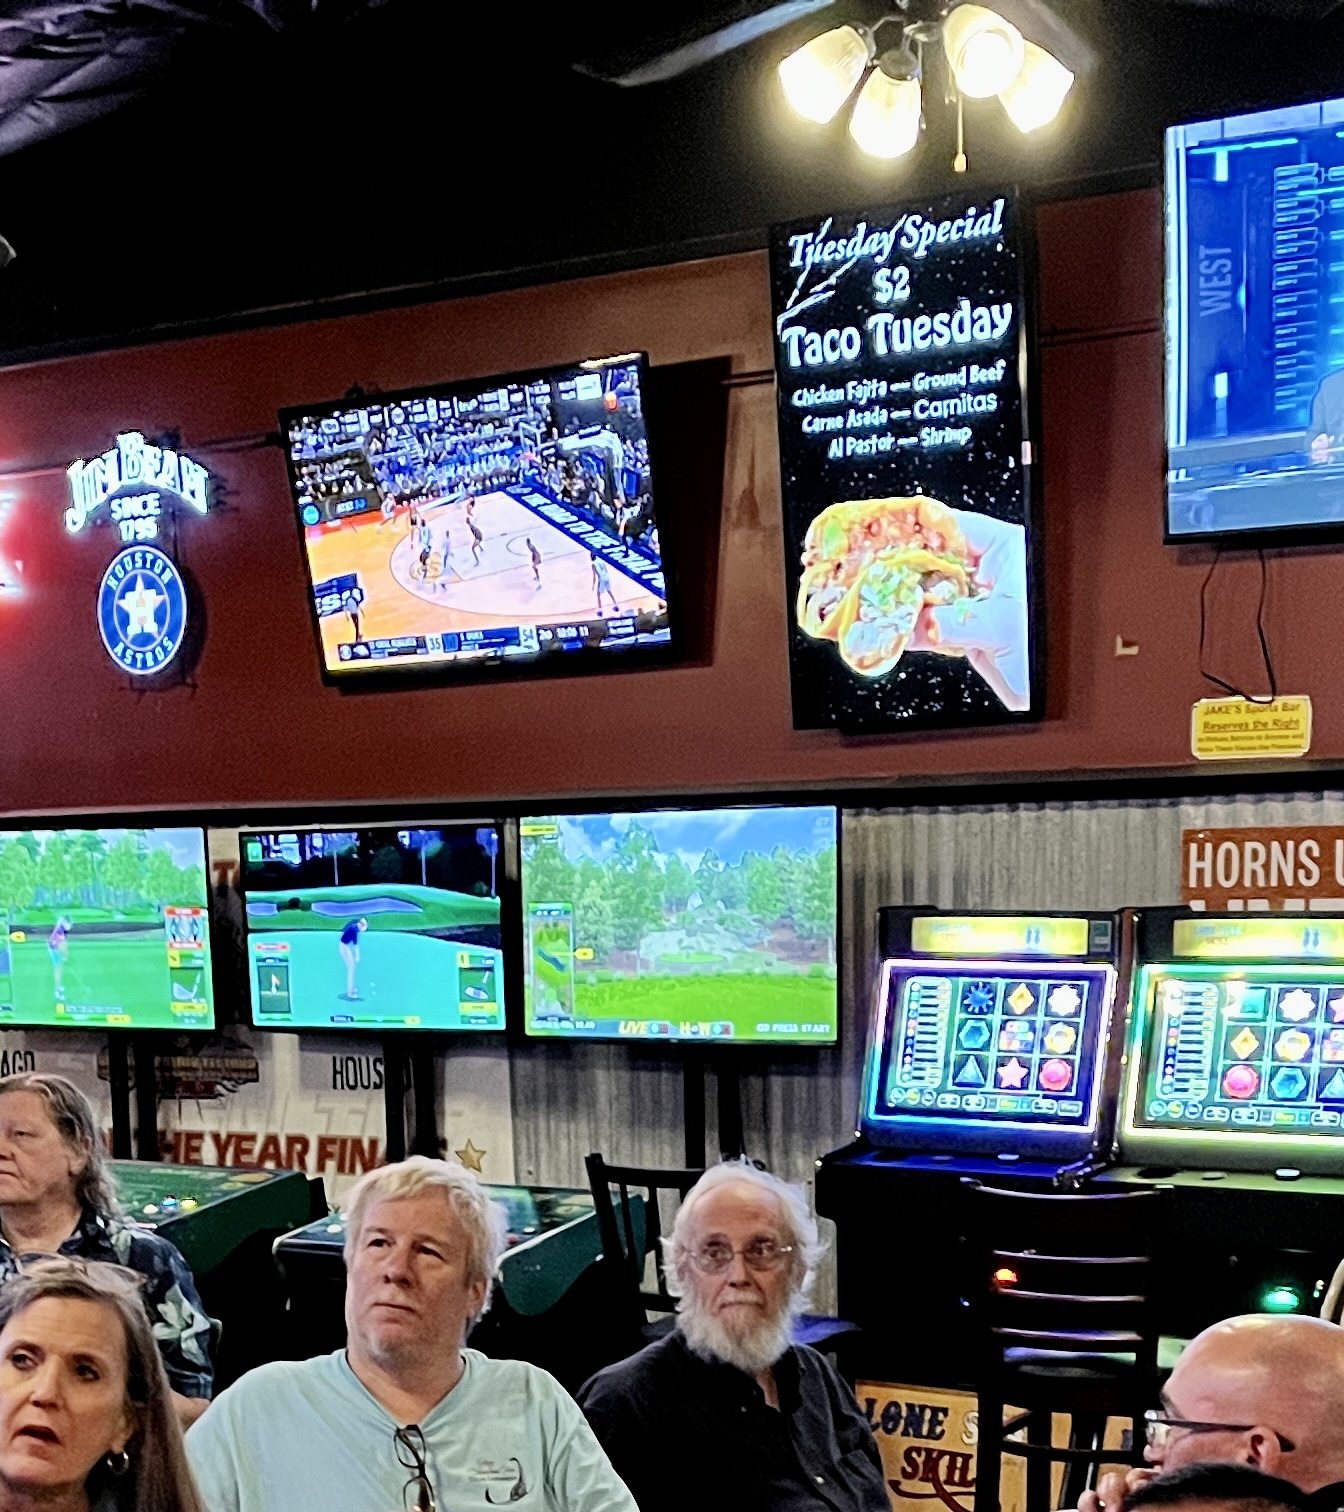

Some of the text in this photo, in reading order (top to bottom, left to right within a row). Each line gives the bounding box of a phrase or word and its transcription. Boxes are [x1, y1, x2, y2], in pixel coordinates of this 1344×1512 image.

[789, 199, 1005, 268] Tuesday Special
[873, 266, 911, 304] $2
[1199, 245, 1232, 317] WEST
[781, 299, 1013, 368] Taco Tuesday
[792, 359, 1007, 407] Chicken Fajita Ground Beef
[802, 392, 998, 433] Carne Asada Carnitas
[828, 427, 972, 459] Al Pastor Shrimp
[111, 492, 161, 520] SINCE
[107, 552, 174, 591] HOUSTON
[113, 635, 174, 669] ASTROS
[1188, 840, 1321, 889] HORNS
[211, 1131, 310, 1174] YEAR
[863, 1398, 950, 1441] LONE
